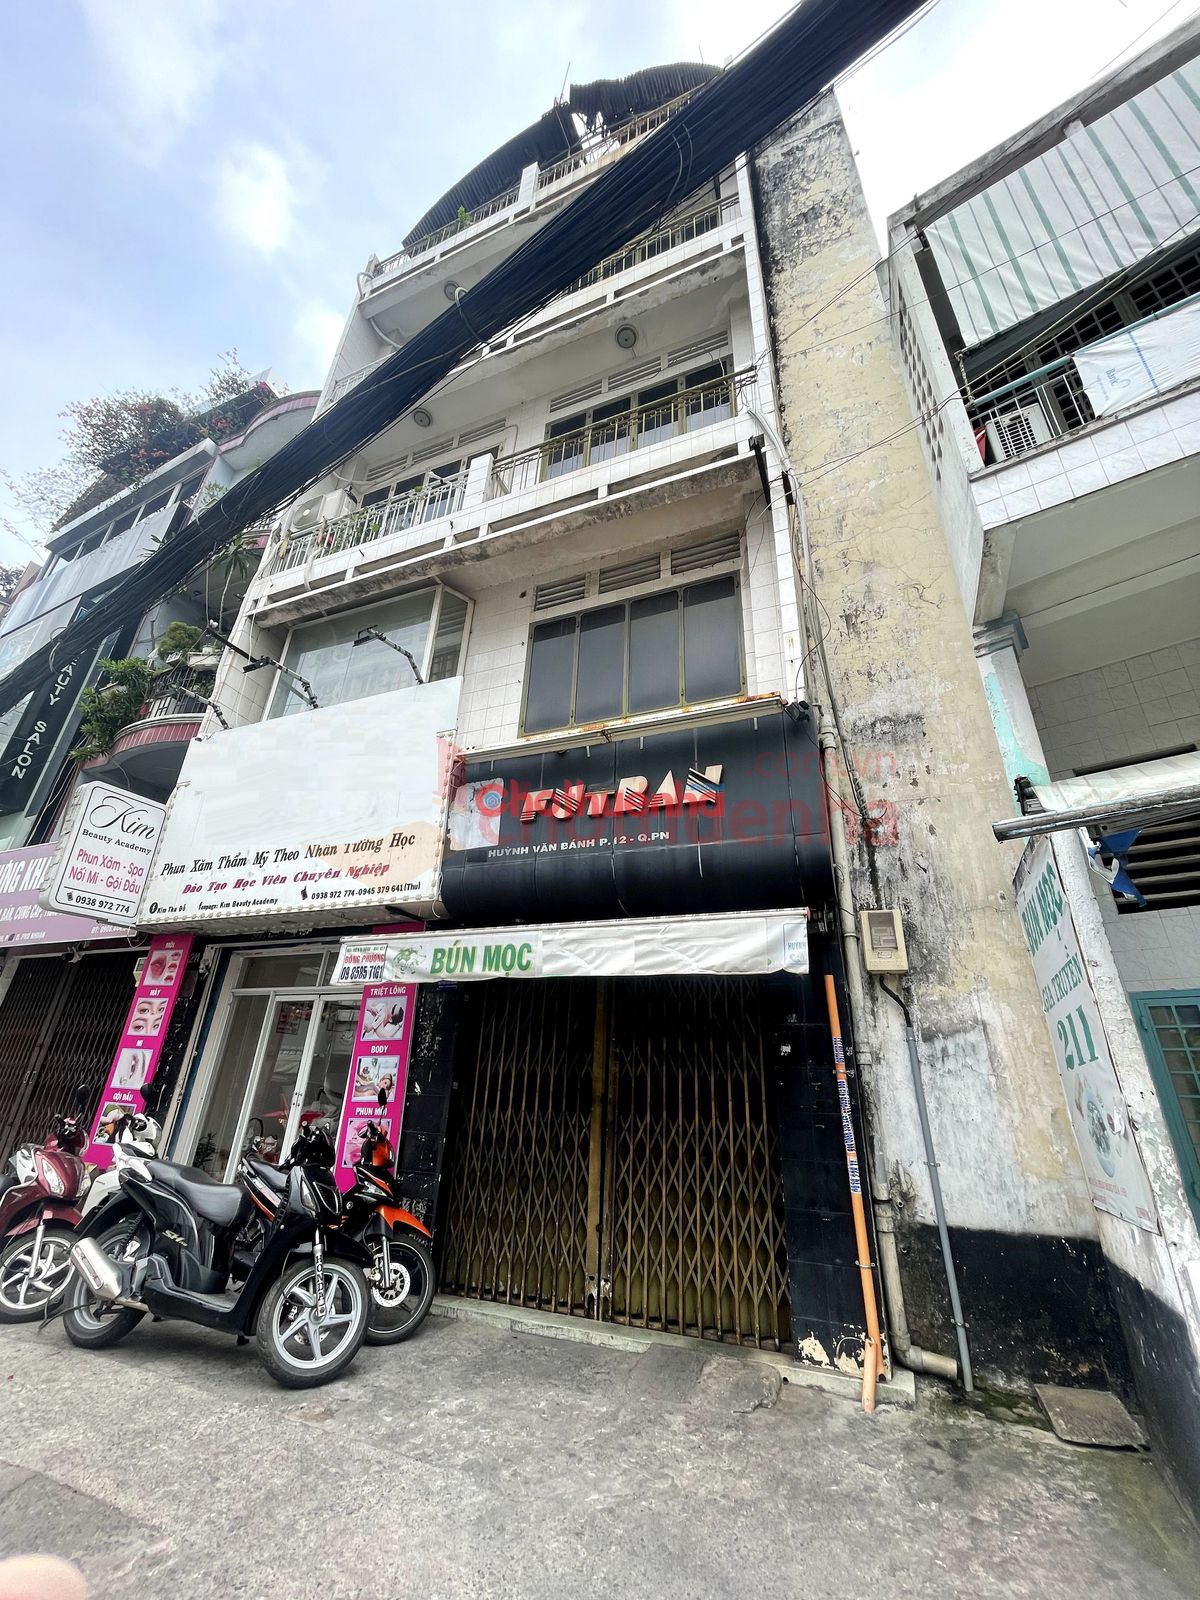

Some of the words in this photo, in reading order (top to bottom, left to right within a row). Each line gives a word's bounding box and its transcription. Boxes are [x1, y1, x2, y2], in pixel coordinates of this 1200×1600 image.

[11, 720, 47, 779] SALON
[89, 795, 155, 840] Kim
[82, 828, 113, 844] Beauty
[114, 838, 152, 856] Academy
[160, 862, 186, 876] Phun
[190, 859, 214, 873] Xăm
[273, 848, 299, 863] Theo
[389, 832, 416, 849] Học
[488, 846, 529, 858] HUỲNH
[533, 841, 557, 854] VĂN
[561, 837, 595, 850] BÁNH
[76, 848, 99, 867] Phun
[100, 853, 121, 871] Xăm
[127, 862, 144, 878] Spa
[68, 865, 86, 881] Nối
[87, 869, 99, 885] Mi
[106, 874, 122, 893] Gội
[207, 881, 228, 894] Tạo
[233, 879, 256, 892] Học
[262, 875, 288, 887] Viên
[293, 868, 341, 883] Chuyên
[345, 863, 390, 879] Nghiệp
[311, 890, 329, 900] 0938
[329, 890, 342, 899] 972
[376, 885, 390, 895] 379
[75, 894, 97, 908] 0938
[98, 900, 114, 912] 972
[115, 904, 131, 915] 774
[220, 901, 231, 909] Kim
[231, 899, 251, 908] Beauty
[252, 897, 279, 907] Academy
[430, 940, 477, 974] BÚN
[482, 943, 533, 977] MỌC
[371, 1045, 389, 1054] BODY
[1057, 1004, 1099, 1071] 211
[355, 1107, 373, 1116] PHUN
